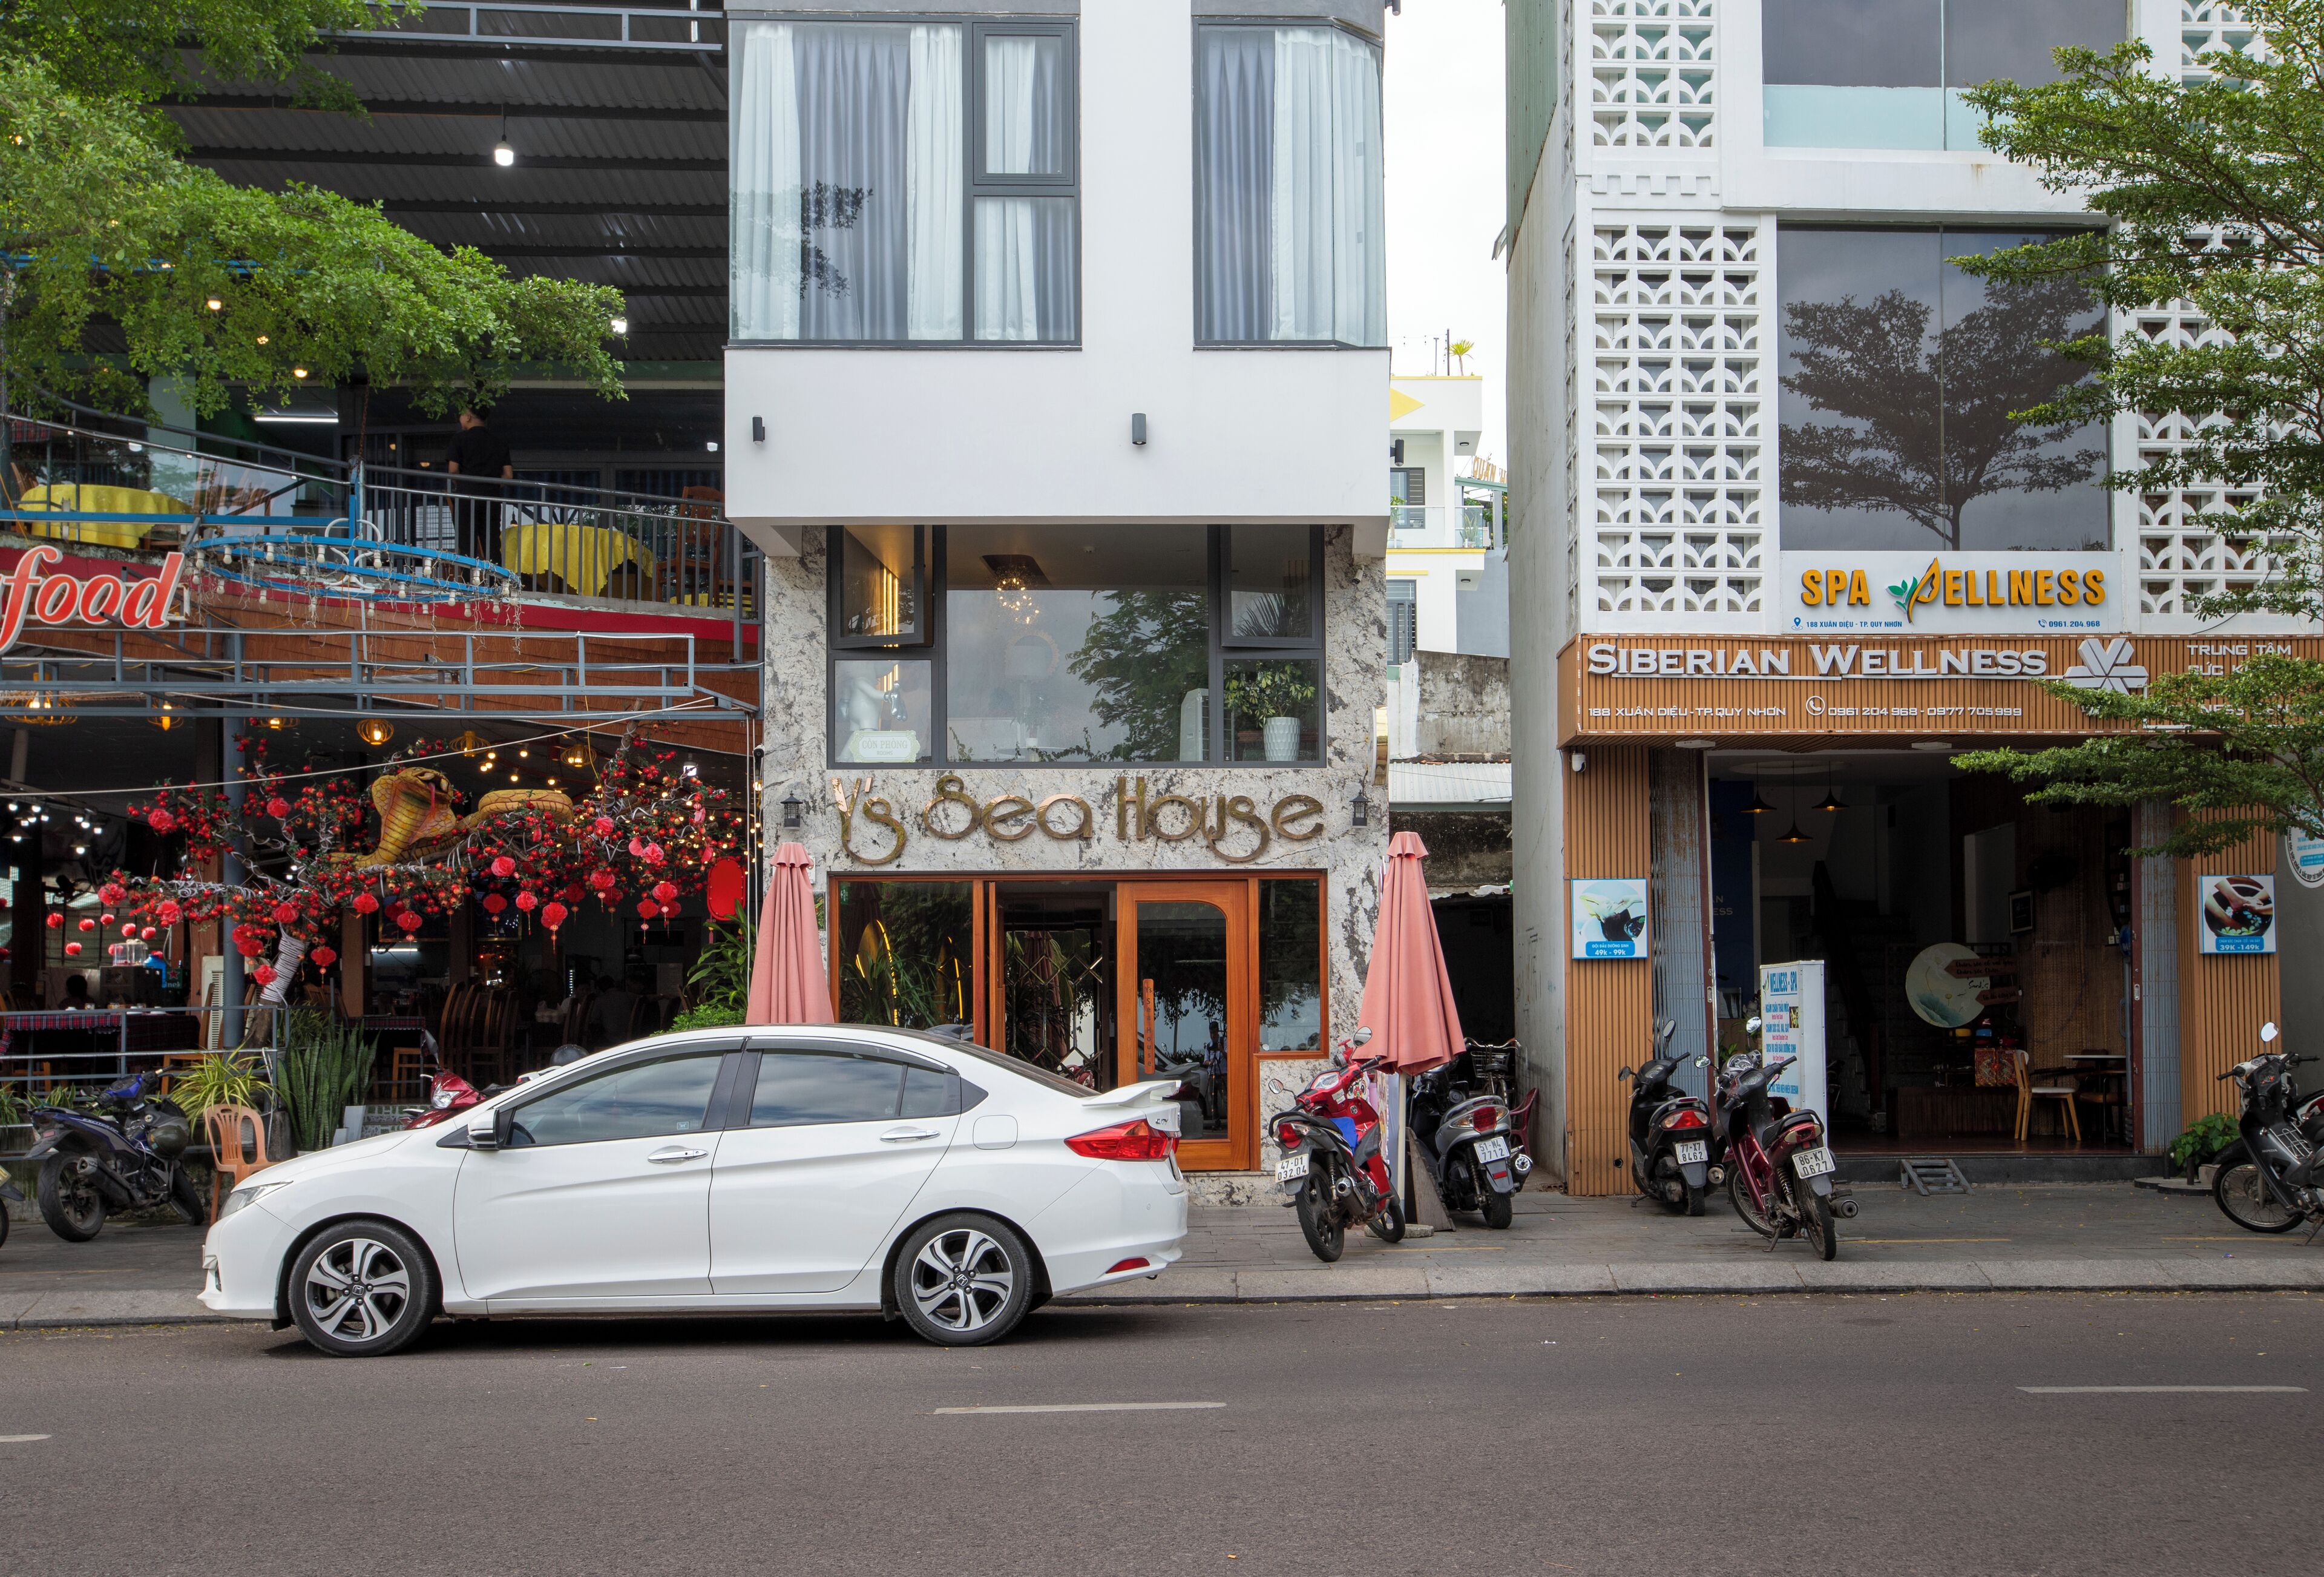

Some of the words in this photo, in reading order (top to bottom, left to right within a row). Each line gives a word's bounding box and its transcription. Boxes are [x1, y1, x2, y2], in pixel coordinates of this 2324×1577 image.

[1801, 569, 1870, 605] SPA
[0, 545, 185, 655] food
[1839, 621, 1854, 629] DIỆU
[2187, 645, 2248, 656] TRUNG
[2256, 642, 2291, 656] TÂM
[1587, 643, 1790, 675] SIBERIAN
[1808, 645, 2047, 675] WELLNESS
[1589, 708, 1610, 717] 188
[1615, 706, 1653, 717] XUÂN
[1658, 705, 1687, 719] DIỆU
[1747, 706, 1786, 717] NHƠN
[1828, 708, 1859, 716] 0961
[1862, 708, 1888, 716] 204
[1891, 708, 1918, 716] 968
[1927, 707, 1965, 716] 0977
[1968, 708, 1993, 716] 705
[1995, 708, 2022, 716] 999
[862, 738, 878, 749] CÒN
[880, 738, 907, 749] PHÒNG
[923, 775, 1093, 840] Sea
[1117, 776, 1324, 863] House
[1770, 972, 1788, 993] WELLNESS
[1482, 1148, 1505, 1161] 7712
[1680, 1142, 1701, 1153] 77-X7
[1281, 1156, 1304, 1170] 47-D1
[1682, 1152, 1704, 1162] 8462
[1798, 1150, 1823, 1166] 86-K7
[1278, 1165, 1307, 1180] 032.04
[1802, 1161, 1828, 1176] 0627
